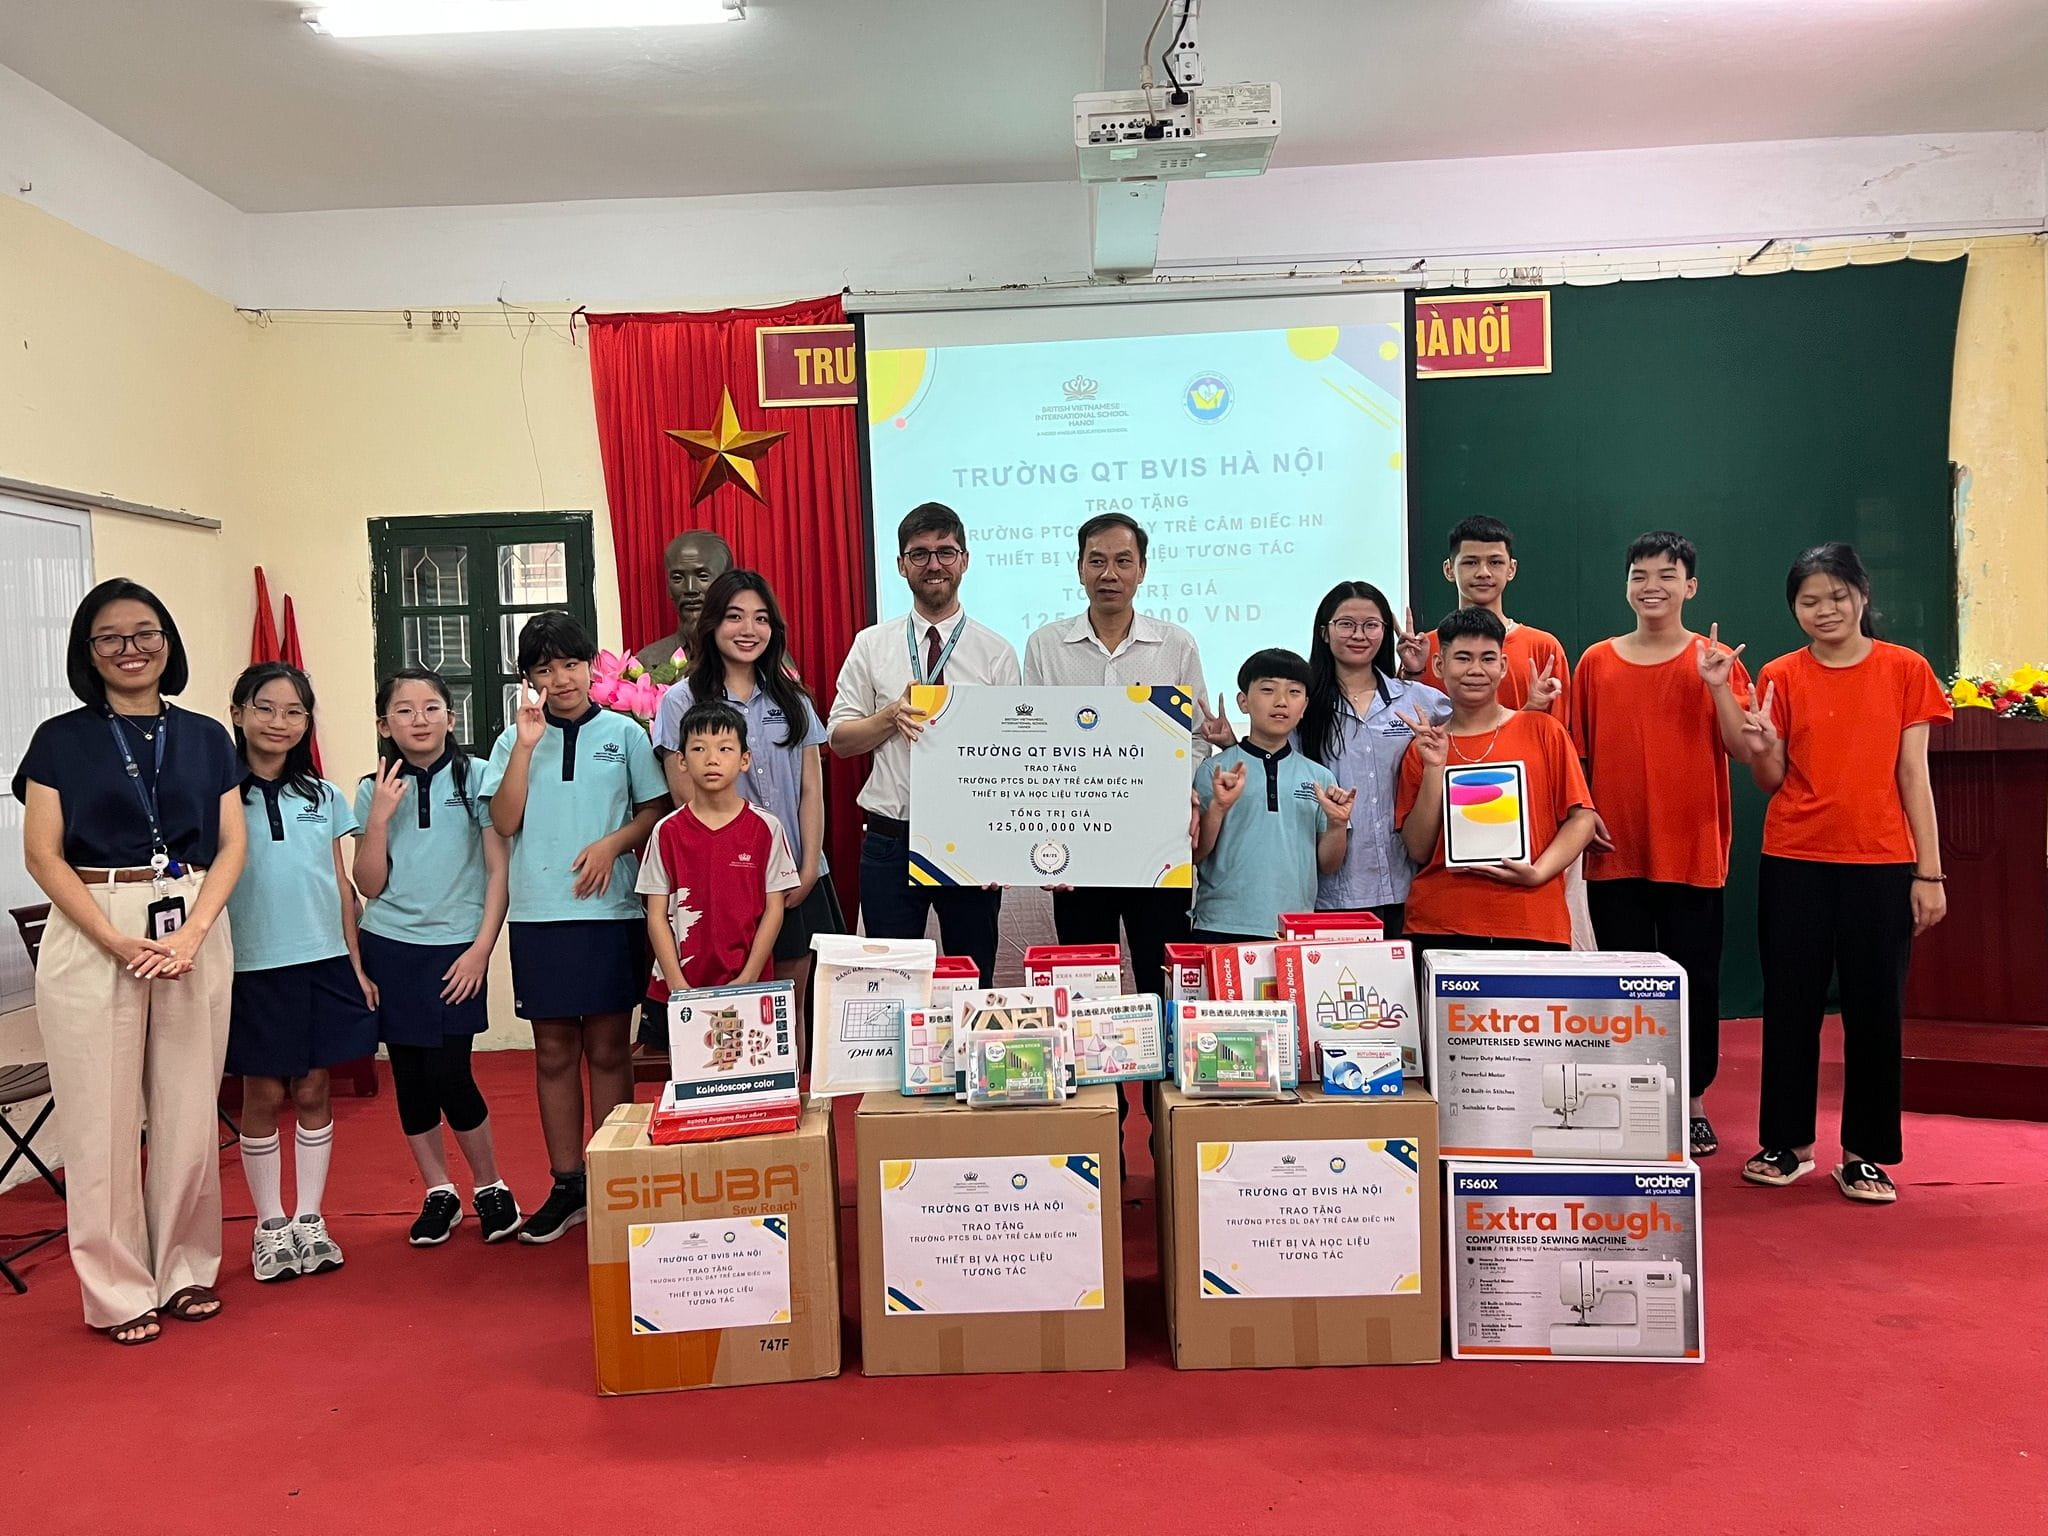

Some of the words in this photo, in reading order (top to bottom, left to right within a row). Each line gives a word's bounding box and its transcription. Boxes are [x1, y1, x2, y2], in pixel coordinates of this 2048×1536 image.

[1452, 305, 1510, 362] NỘI
[953, 461, 1079, 488] TRƯỜNG
[1091, 462, 1128, 483] QT
[1141, 457, 1207, 481] BVIS
[1220, 449, 1260, 476] HÀ
[1273, 446, 1324, 477] NỘI
[1085, 497, 1133, 512] TRAO
[1140, 493, 1189, 511] TẶNG
[968, 524, 1034, 542] RƯỜNG
[1041, 525, 1079, 539] PTC
[1206, 516, 1243, 530] CÂM
[1299, 513, 1323, 527] HN
[1186, 543, 1252, 559] TƯƠNG
[1259, 541, 1294, 556] TÁC
[1181, 582, 1218, 597] GIÁ
[1205, 603, 1262, 623] VND
[958, 745, 1021, 758] TRƯỜNG
[1028, 746, 1047, 758] QT
[1053, 746, 1086, 757] BVIS
[1093, 744, 1112, 757] HÀ
[1118, 744, 1144, 760] NỘI
[1024, 764, 1048, 772] TRAO
[1052, 763, 1077, 774] TẶNG
[958, 775, 998, 785] TRƯỜNG
[1001, 777, 1024, 785] PTCS
[1000, 790, 1010, 800] BỊ
[1013, 788, 1025, 798] VÀ
[1029, 790, 1048, 800] HỌC
[1052, 788, 1071, 801] LIỆU
[1075, 789, 1108, 799] TƯƠNG
[1112, 788, 1129, 799] TÁC
[1047, 809, 1065, 819] TRỊ
[1071, 807, 1090, 818] GIÁ
[988, 822, 1075, 833] 125,000,000
[1083, 822, 1113, 832] VND
[1287, 957, 1295, 986] blocks
[1441, 980, 1480, 991] FS60X
[1619, 977, 1675, 992] brother
[1447, 1004, 1539, 1034] Extra
[1547, 1004, 1667, 1044] Tough.
[1447, 1037, 1520, 1047] COMPUTERISED
[1523, 1038, 1562, 1048] SEWING
[1565, 1039, 1610, 1048] MACHINE
[1461, 1055, 1478, 1063] Heavy
[1480, 1055, 1493, 1063] Duty
[754, 1079, 775, 1088] color
[1460, 1179, 1498, 1190] FS60X
[1635, 1174, 1690, 1188] brother
[1239, 1186, 1287, 1197] TRƯỜNG
[1292, 1188, 1307, 1197] QT
[1312, 1187, 1338, 1196] BVIS
[1343, 1185, 1357, 1195] HÀ
[1362, 1184, 1382, 1197] NỘI
[733, 1204, 758, 1216] Sew
[761, 1201, 797, 1213] Reach
[921, 1203, 970, 1214] TRƯỜNG
[975, 1203, 989, 1213] QT
[994, 1203, 1020, 1212] BVIS
[1024, 1201, 1039, 1211] HÀ
[1044, 1200, 1064, 1212] NỘI
[1280, 1207, 1309, 1215] TRAO
[1313, 1205, 1342, 1215] TẶNG
[962, 1223, 991, 1231] TRAO
[995, 1220, 1024, 1232] TẶNG
[1466, 1202, 1556, 1231] Extra
[1564, 1201, 1683, 1240] Tough.
[1252, 1237, 1282, 1248] THIẾT
[1286, 1239, 1297, 1248] BỊ
[1302, 1237, 1315, 1247] VÀ
[1320, 1238, 1342, 1248] HỌC
[1347, 1237, 1370, 1247] LIỆU
[1465, 1235, 1538, 1245] COMPUTERISED
[1541, 1236, 1579, 1245] SEWING
[1582, 1236, 1627, 1245] MACHINE
[658, 1254, 694, 1264] TRƯỜNG
[697, 1254, 708, 1262] QT
[711, 1252, 730, 1260] BVIS
[733, 1249, 745, 1258] HÀ
[747, 1248, 762, 1259] NỘI
[936, 1254, 965, 1264] THIẾT
[969, 1256, 980, 1265] BỊ
[985, 1253, 999, 1263] VÀ
[1003, 1254, 1025, 1264] HỌC
[1030, 1252, 1053, 1263] LIỆU
[1279, 1251, 1318, 1260] TƯƠNG
[1323, 1249, 1344, 1259] TÁC
[962, 1267, 1001, 1276] TƯƠNG
[1006, 1265, 1027, 1275] TÁC
[760, 1338, 789, 1351] 747F
